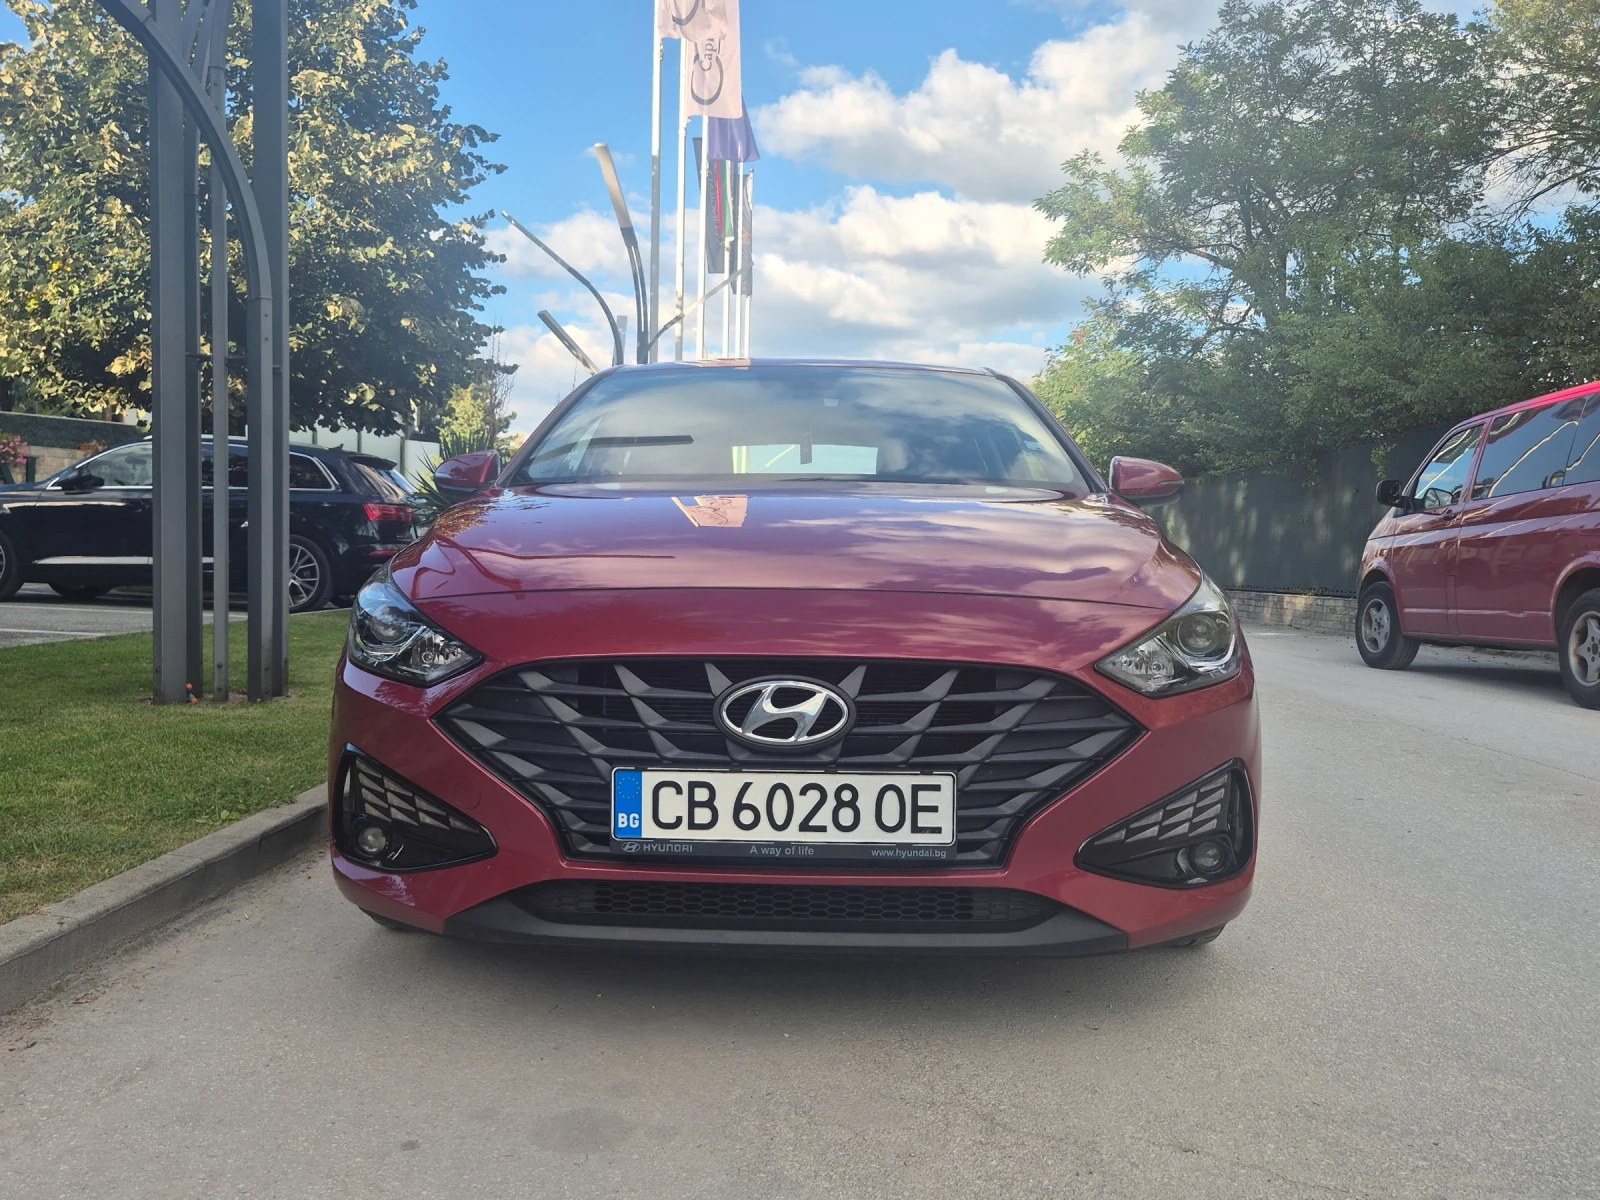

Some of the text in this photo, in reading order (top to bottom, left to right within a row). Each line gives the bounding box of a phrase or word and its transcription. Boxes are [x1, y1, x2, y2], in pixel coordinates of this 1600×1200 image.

[652, 780, 943, 834] CB 6028 OE
[617, 813, 640, 829] BG
[643, 843, 693, 853] HYUNDAI
[750, 845, 815, 857] A way of life
[871, 849, 947, 859] www.hyundai.bg
